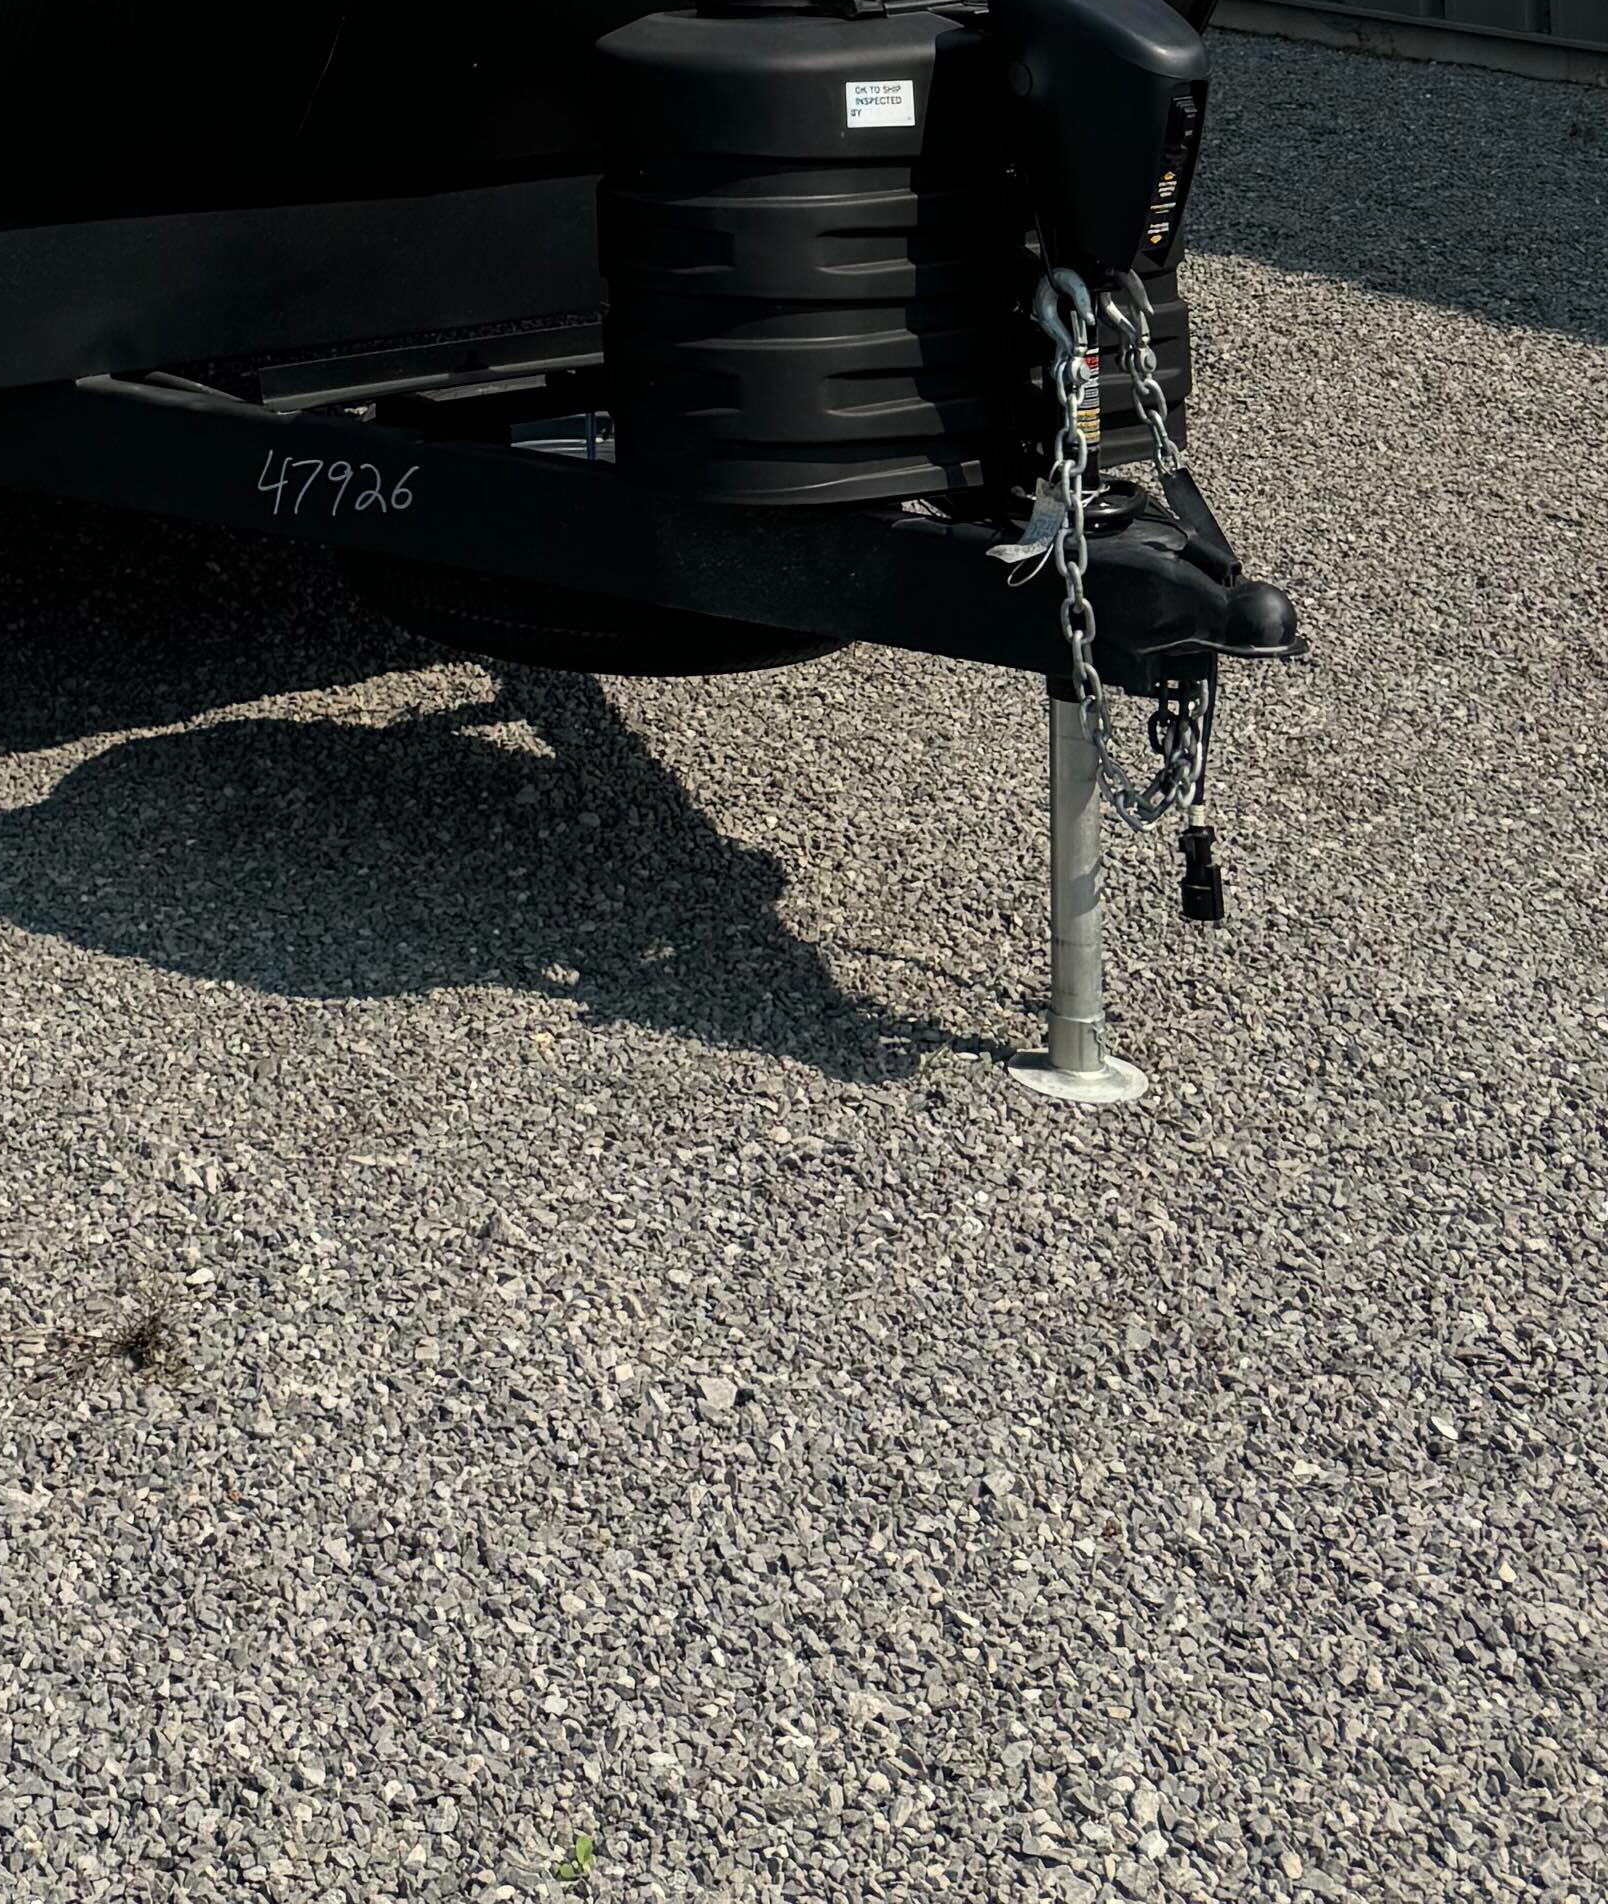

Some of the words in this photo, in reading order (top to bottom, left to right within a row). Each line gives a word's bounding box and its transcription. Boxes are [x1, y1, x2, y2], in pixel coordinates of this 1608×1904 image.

[869, 86, 880, 94] TO
[855, 96, 902, 105] INSPECTED
[257, 450, 420, 516] 47926
